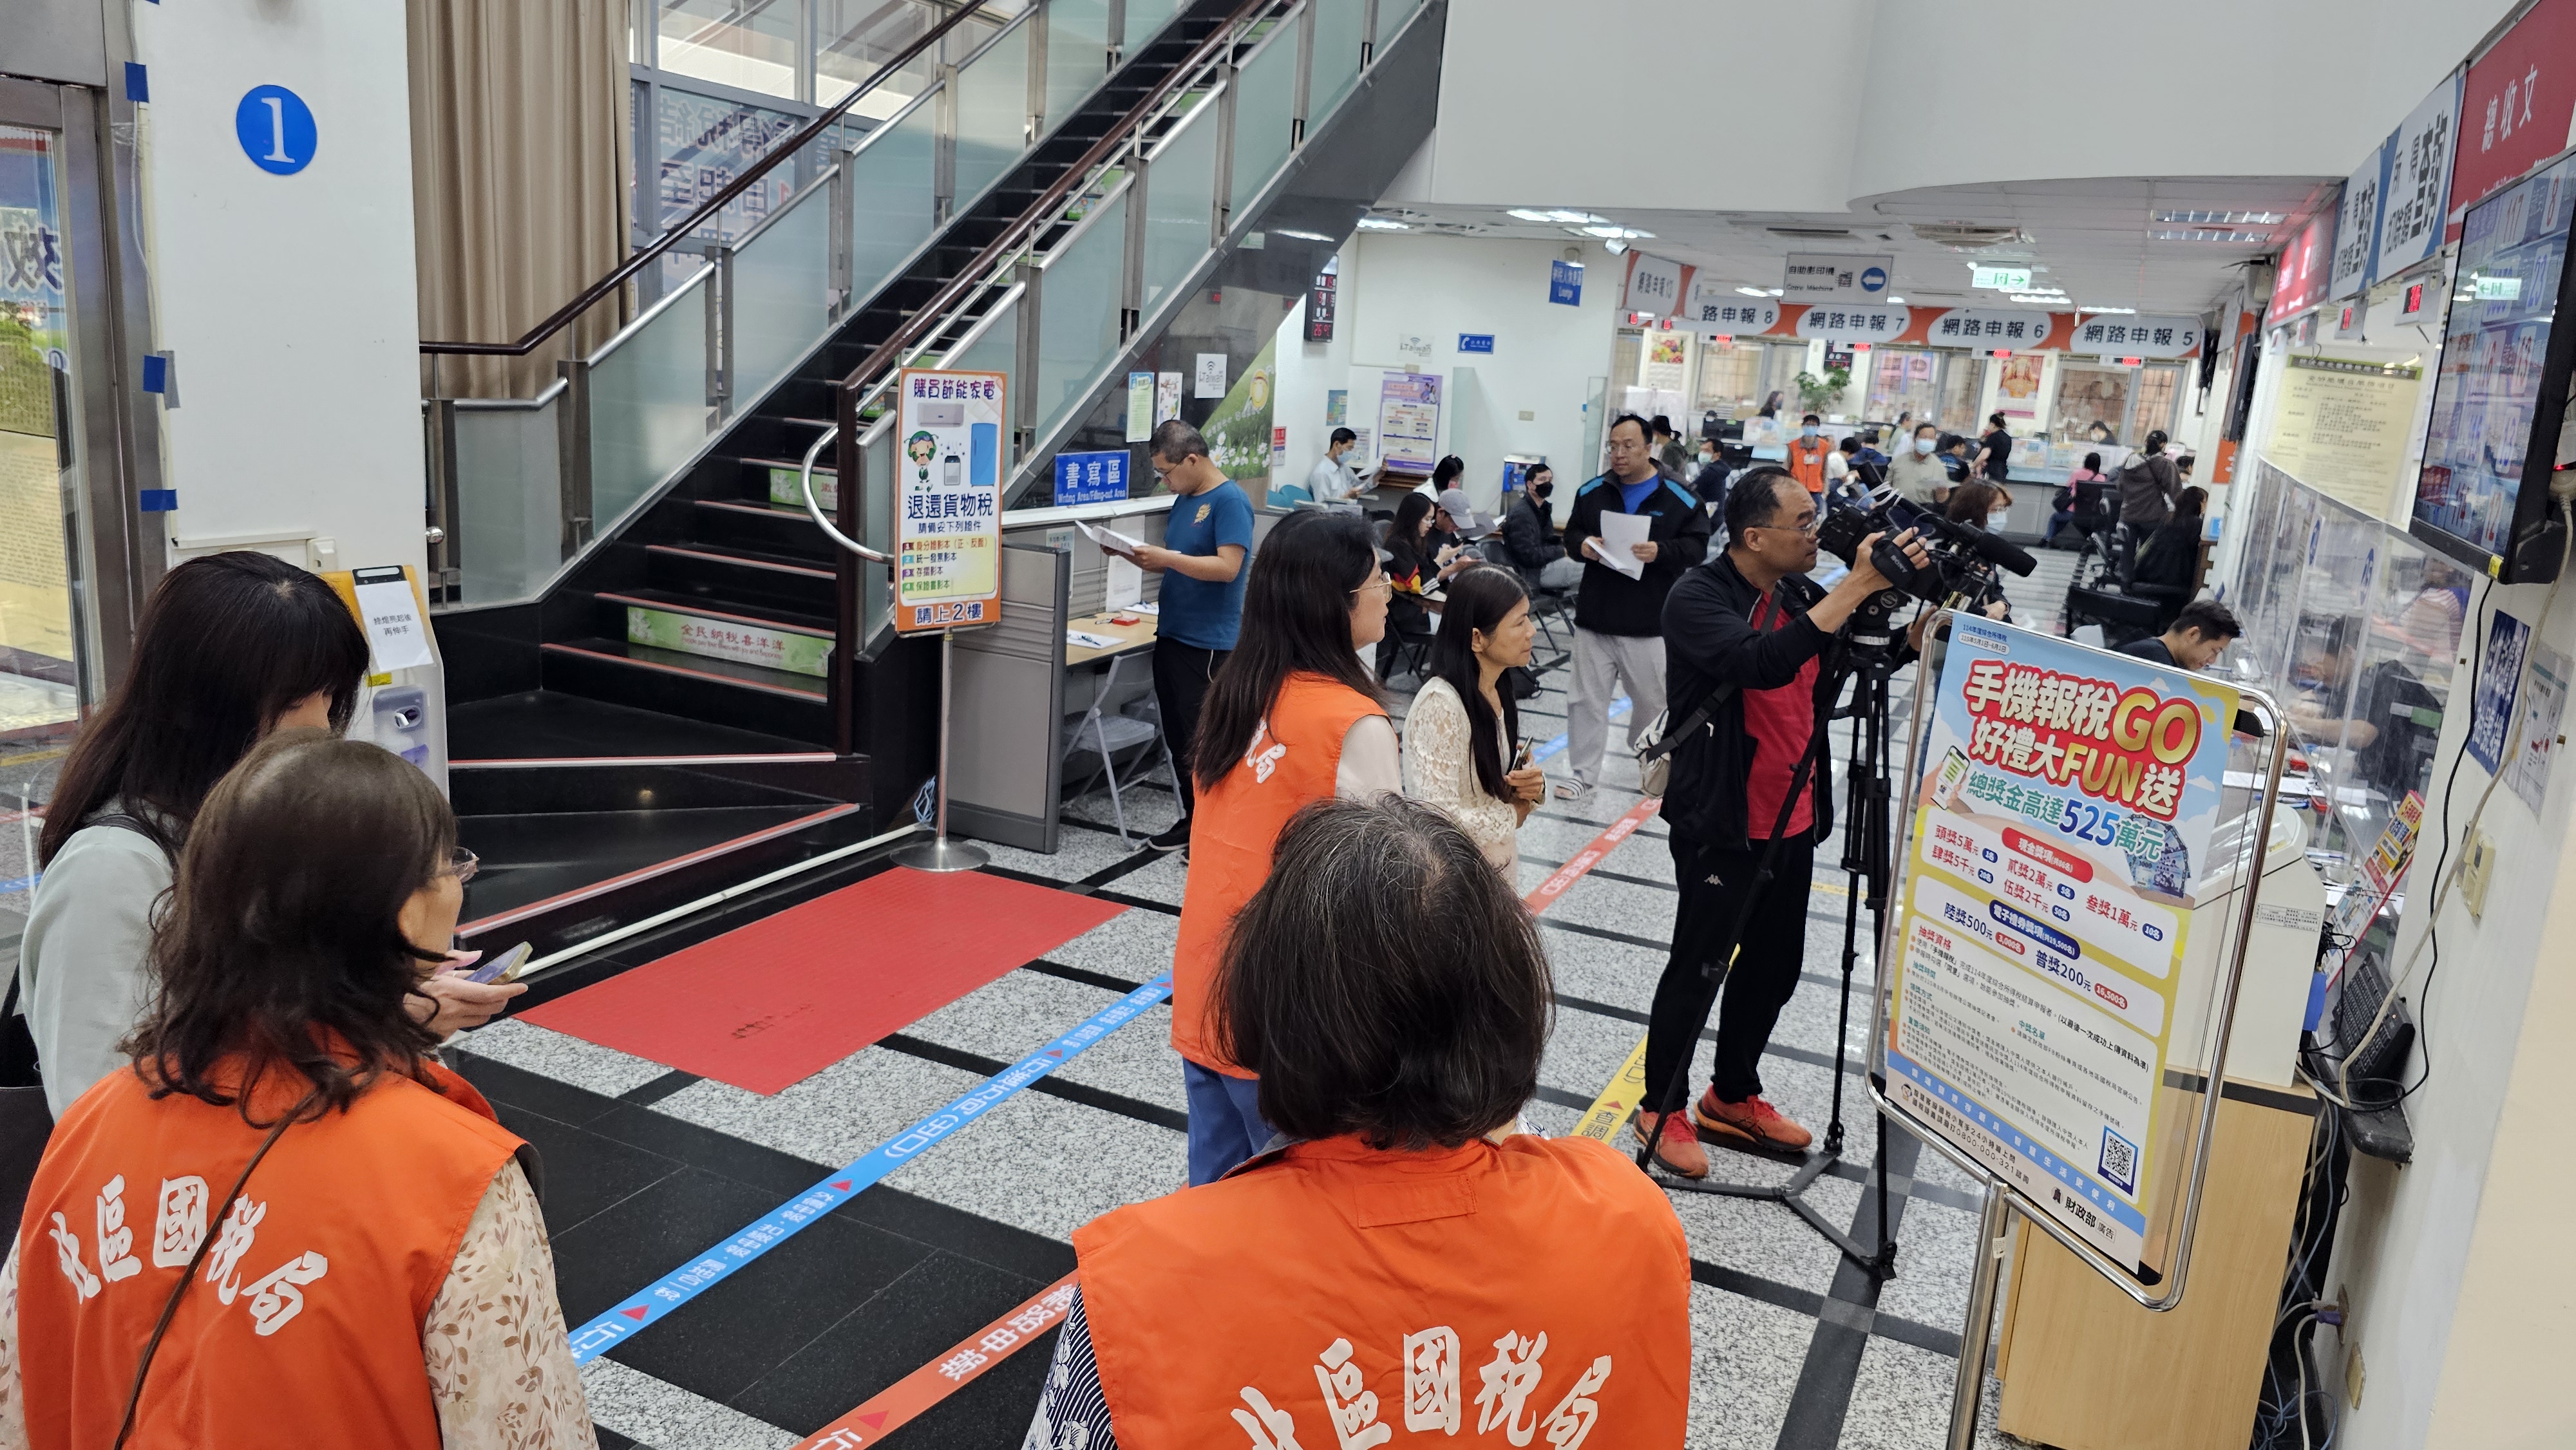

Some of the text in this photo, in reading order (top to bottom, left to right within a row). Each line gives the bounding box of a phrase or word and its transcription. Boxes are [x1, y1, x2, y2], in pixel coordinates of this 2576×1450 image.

[261, 96, 296, 164] 1
[2482, 64, 2537, 153] 總收文
[2546, 174, 2559, 227] 8
[2528, 254, 2548, 308] 23
[1763, 311, 1774, 325] 8
[1808, 312, 1905, 332] 網路申報 7
[1941, 317, 2044, 339] 網路申報 6
[2083, 323, 2193, 346] 網路申報 5
[1066, 459, 1121, 489] 書寫區
[908, 493, 993, 520] 退還貨物稅
[918, 520, 982, 534] 請備妥下列證件
[916, 552, 957, 563] 統一發票影本
[383, 625, 410, 637] 再伸手
[681, 623, 786, 651] 全民納稅喜洋洋
[916, 603, 982, 625] 請上2樓
[1966, 664, 2197, 764] 手機報稅GO
[1973, 720, 2181, 816] 好禮大FUN送
[1967, 770, 2164, 862] 總獎金高達525萬元
[1931, 844, 1975, 876] 肆獎5千元
[2003, 878, 2049, 913] 伍獎2千元
[2053, 907, 2067, 920] 50名
[1935, 824, 1979, 855] 頭獎5萬元
[2007, 856, 2054, 892] 貳獎2萬元
[2060, 886, 2071, 898] 5名
[2144, 925, 2160, 940] 10名
[1918, 923, 1951, 952] 抽獎資格
[1944, 901, 1993, 941] 陸獎500元
[2035, 948, 2092, 992] 普獎200元
[2096, 984, 2125, 1008] 16,500名
[2018, 1018, 2045, 1042] 中獎名單
[884, 1056, 1054, 1158] 行進方向(出口)
[2065, 1195, 2114, 1241] 財政部 廣告
[50, 1174, 328, 1335] 北區國稅局
[938, 1283, 1075, 1381] 網路申報
